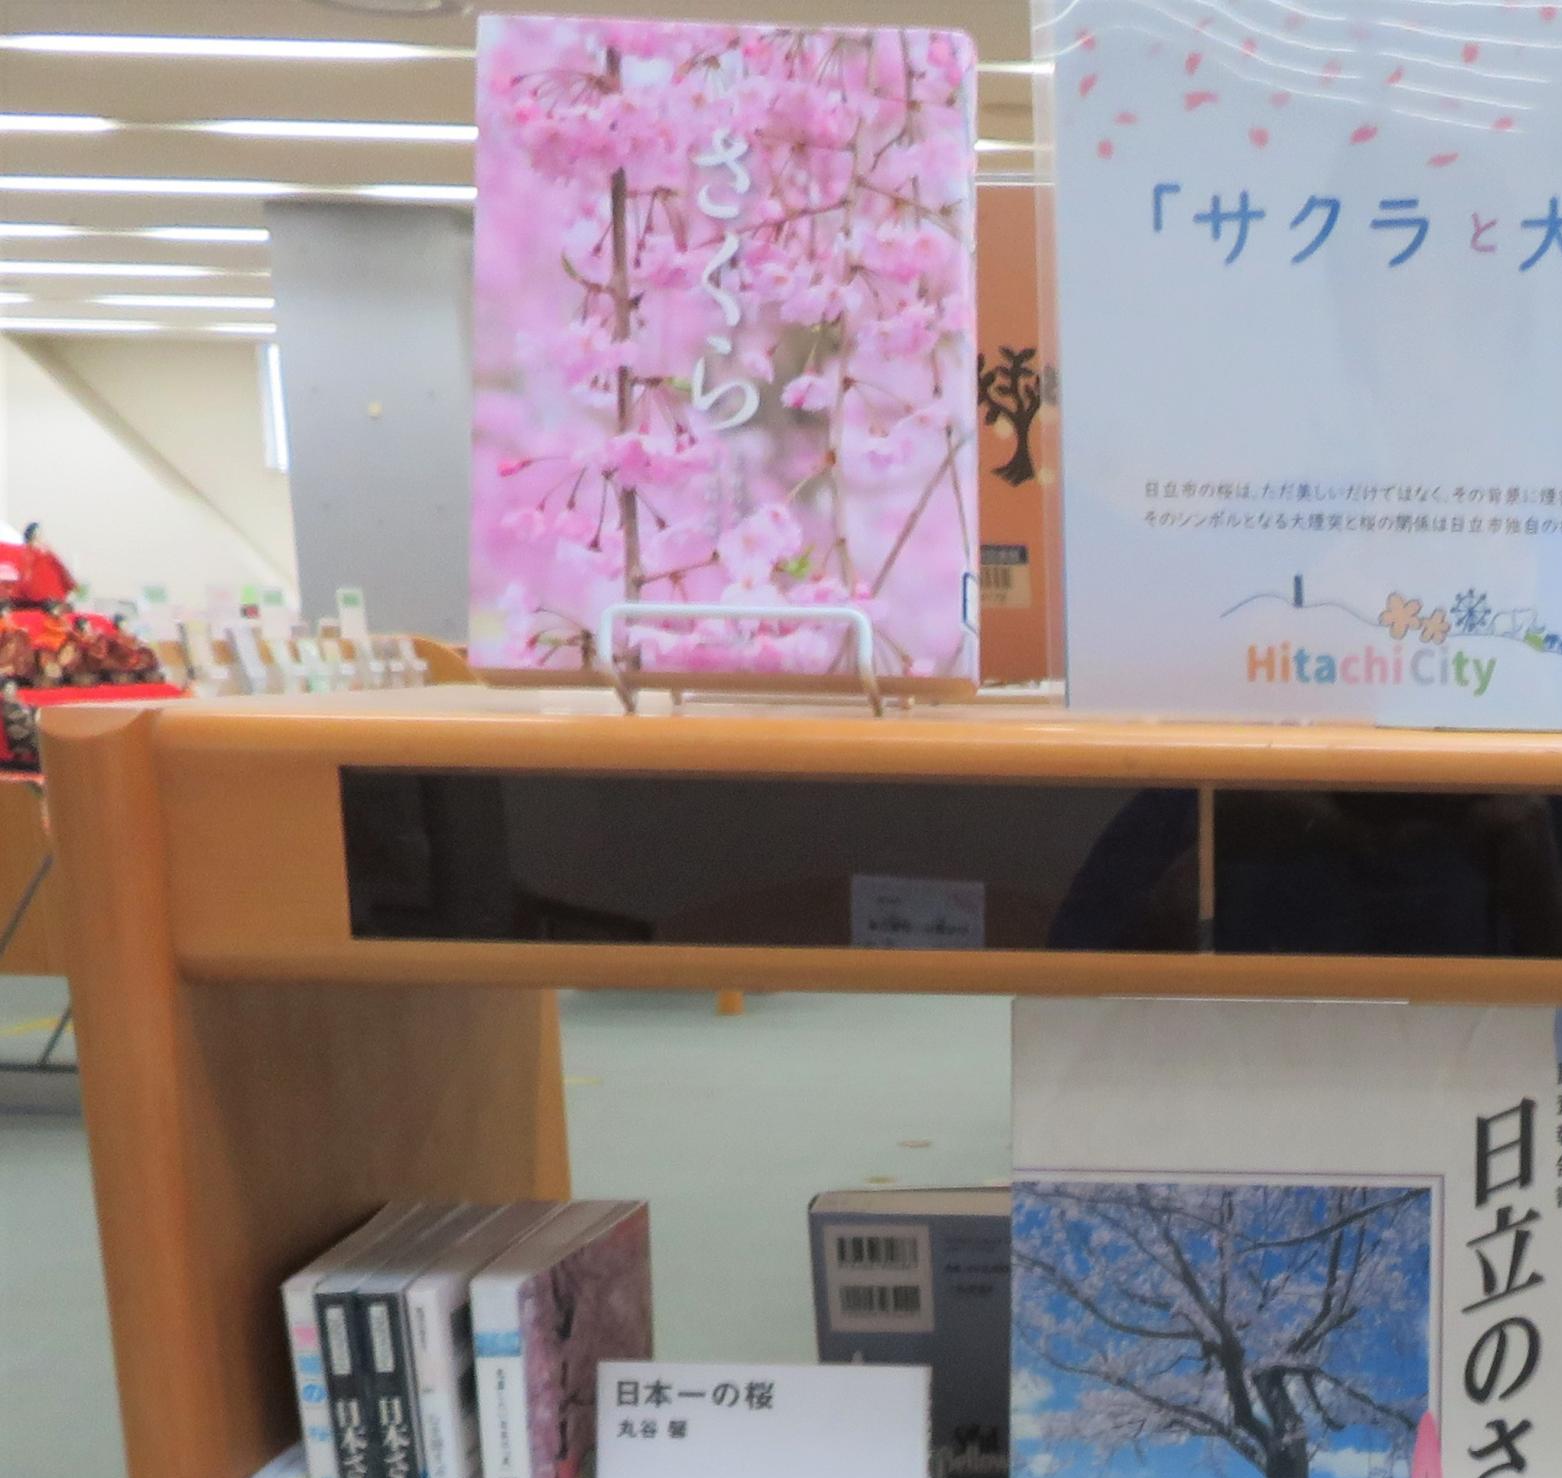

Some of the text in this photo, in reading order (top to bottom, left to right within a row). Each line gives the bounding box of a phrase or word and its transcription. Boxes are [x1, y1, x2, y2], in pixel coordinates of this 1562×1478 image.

[691, 129, 760, 431] さくら
[615, 1379, 776, 1411] 日本一の桜
